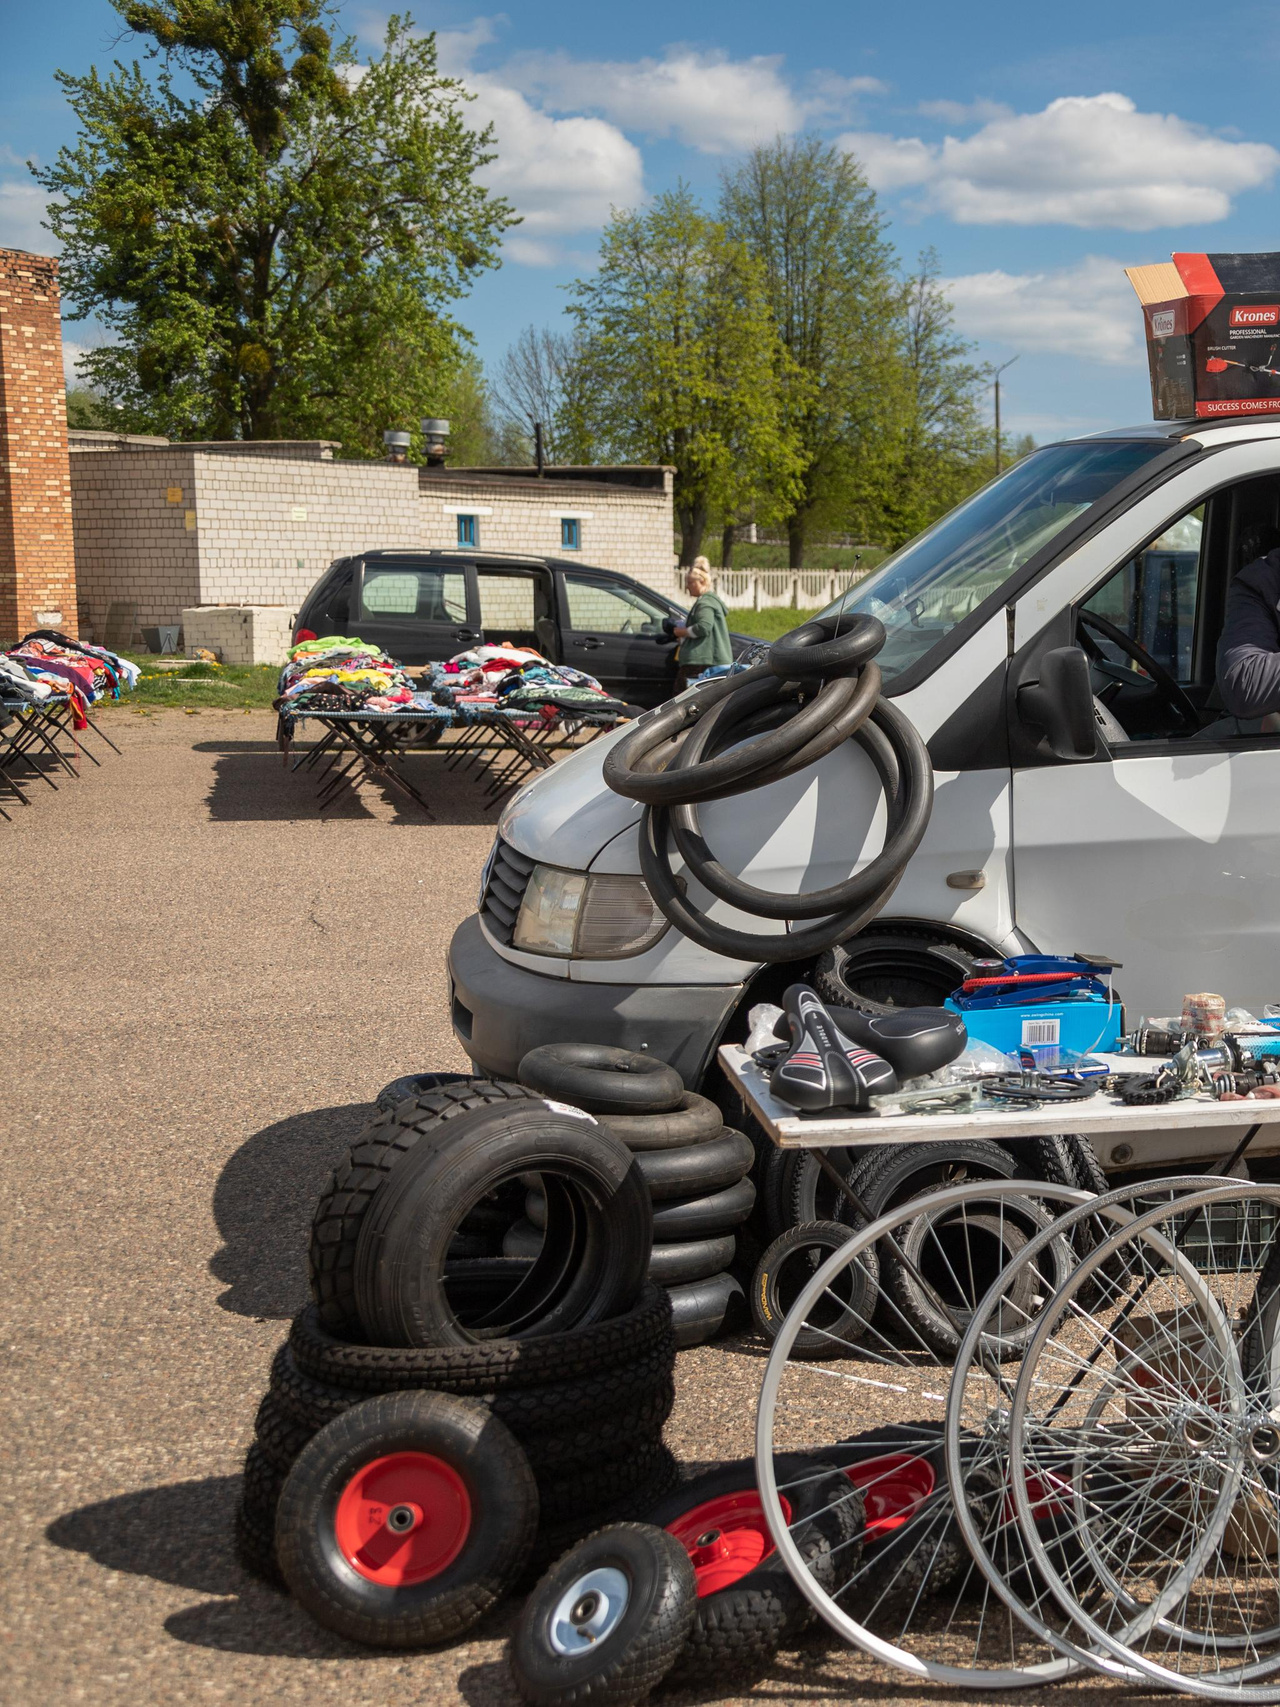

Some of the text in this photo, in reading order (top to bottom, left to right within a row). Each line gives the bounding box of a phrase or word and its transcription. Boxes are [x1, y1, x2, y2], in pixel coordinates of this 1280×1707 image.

[1234, 310, 1276, 322] Krones
[1207, 403, 1240, 412] SUCCESS
[1241, 401, 1267, 410] COMES
